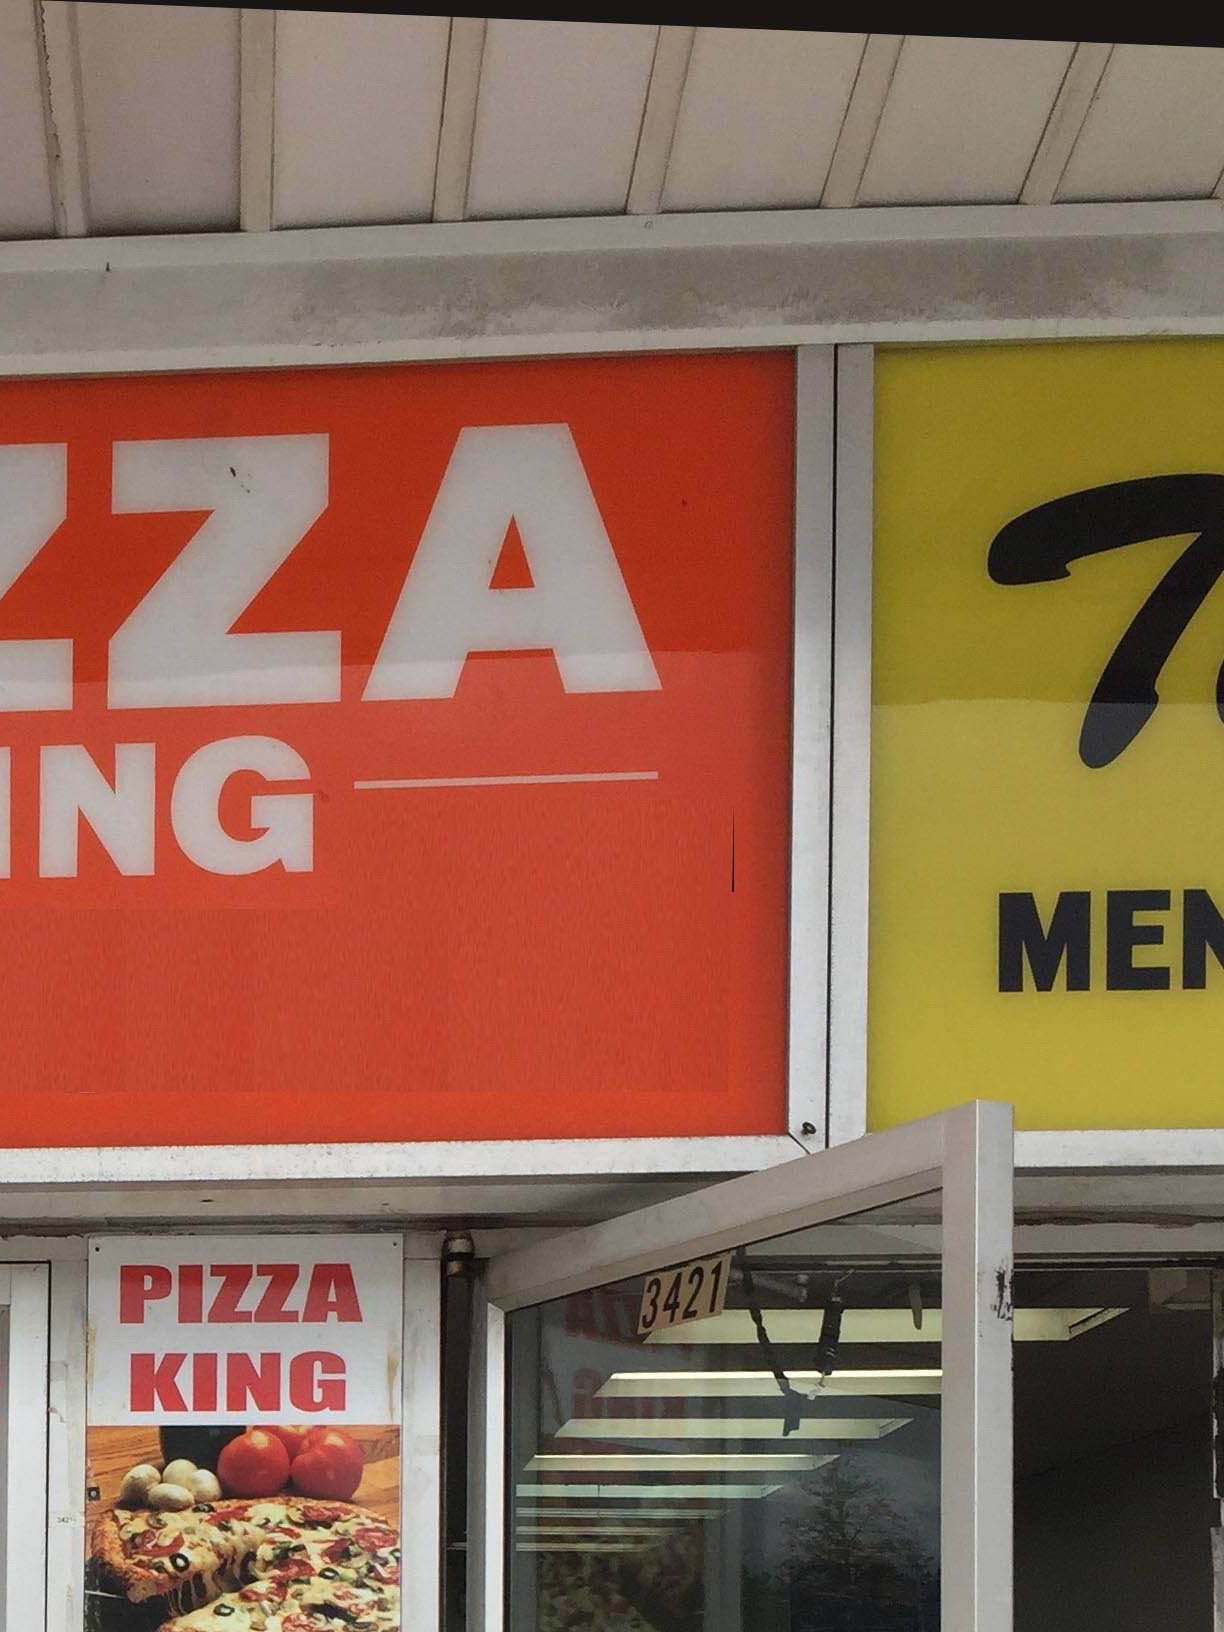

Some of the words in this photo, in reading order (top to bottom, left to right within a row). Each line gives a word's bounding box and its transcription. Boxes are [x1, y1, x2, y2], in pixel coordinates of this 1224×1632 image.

[987, 473, 1224, 768] T
[119, 1263, 363, 1324] PIZZA
[642, 1261, 723, 1329] 3421
[129, 1351, 348, 1413] KING
